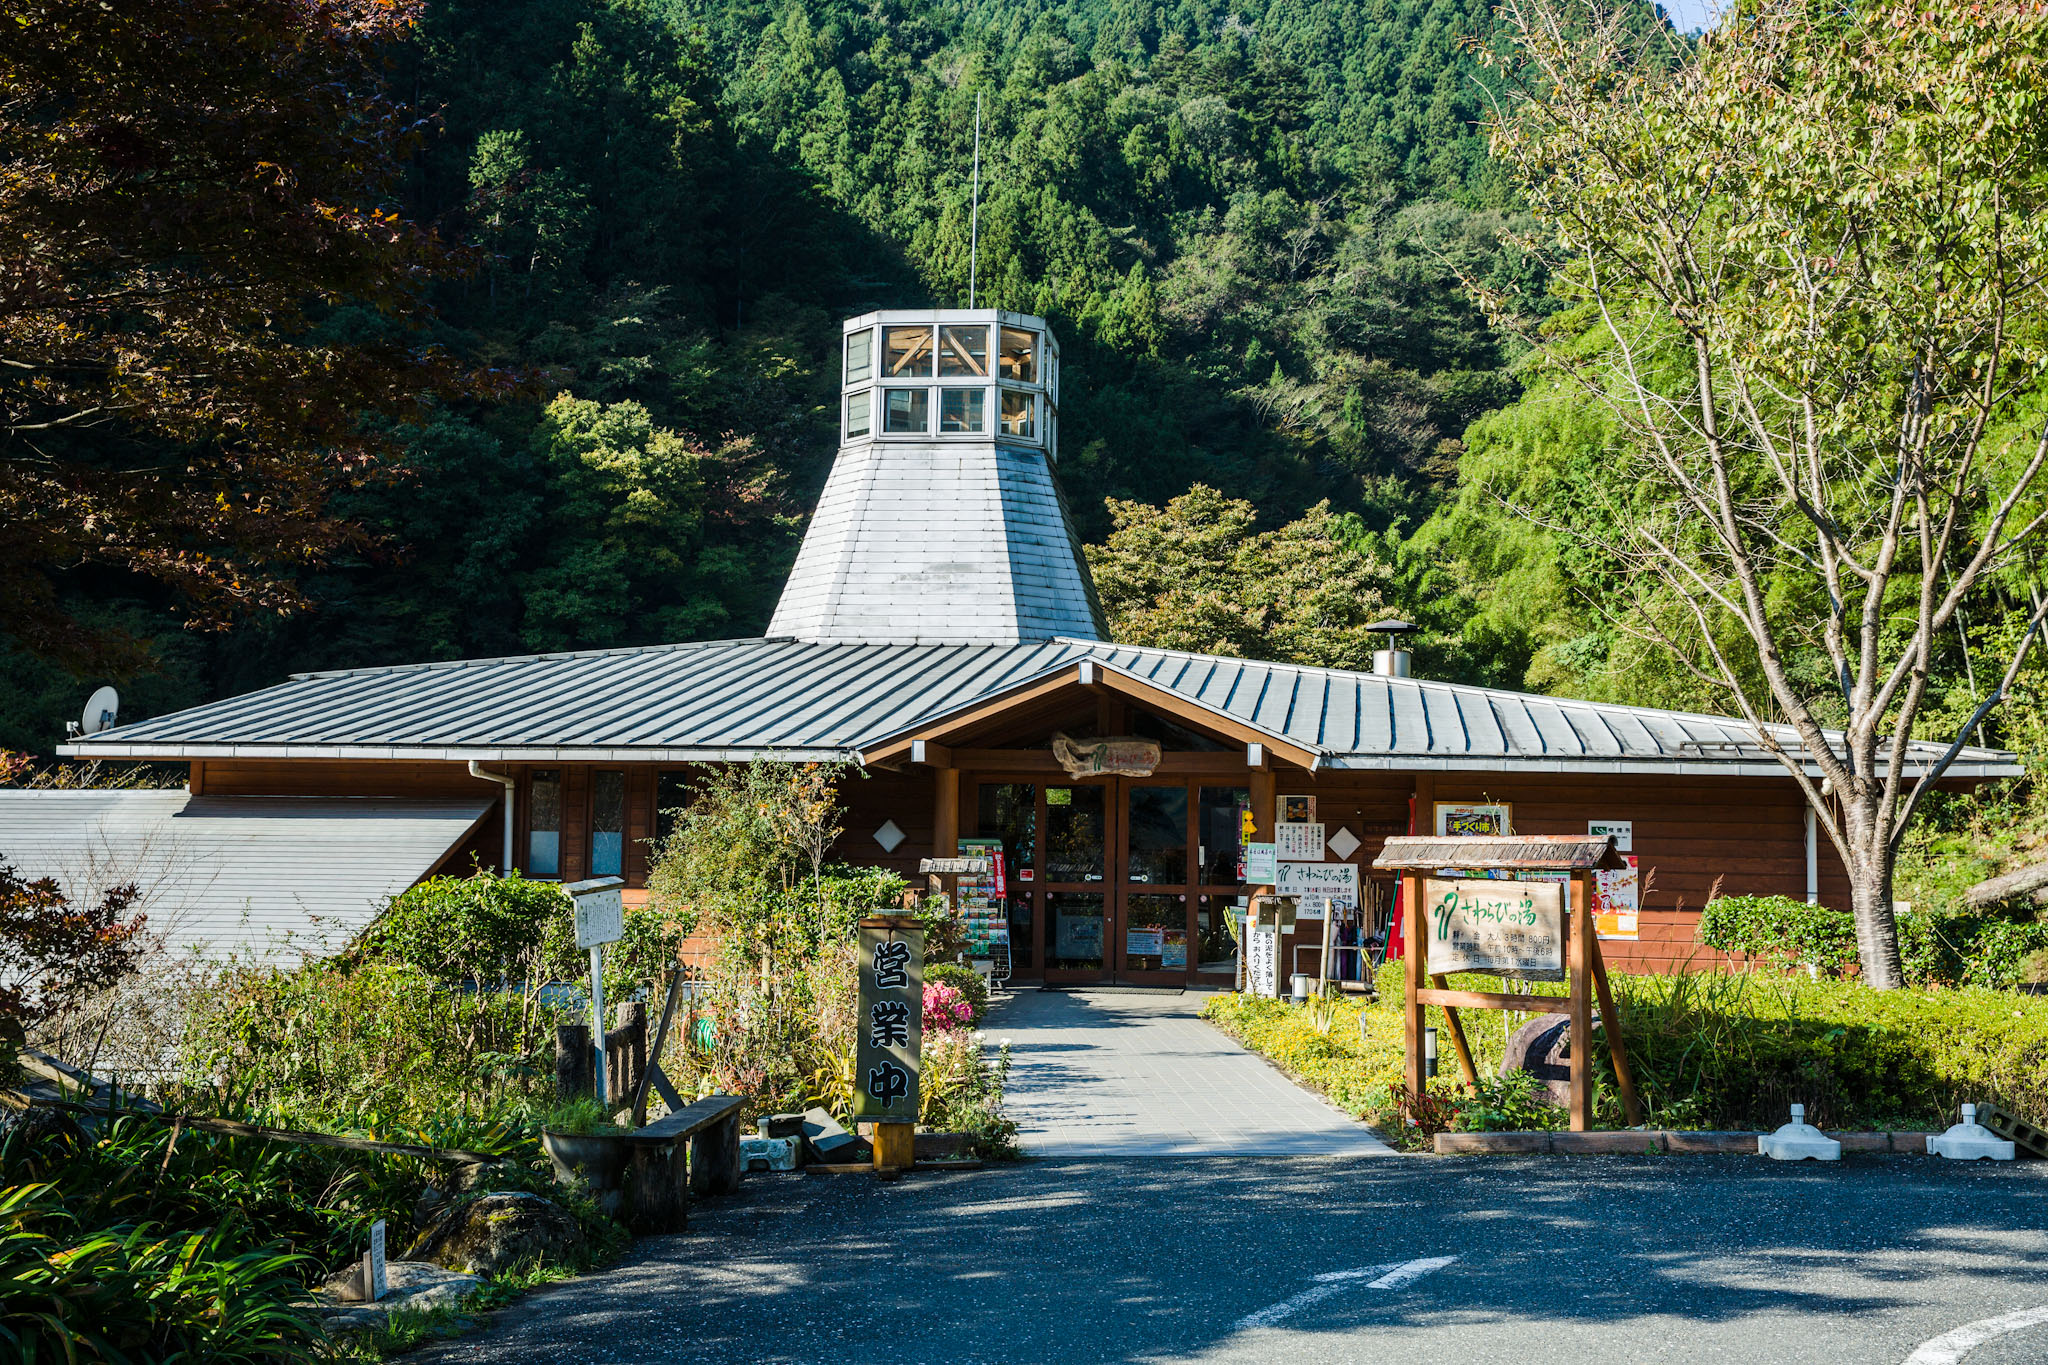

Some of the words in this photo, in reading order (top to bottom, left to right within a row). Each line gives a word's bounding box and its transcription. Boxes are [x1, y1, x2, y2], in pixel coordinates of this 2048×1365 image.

[1296, 866, 1353, 884] さわらびの湯
[1461, 898, 1537, 926] さわらびの湯
[1528, 935, 1550, 945] 800円
[868, 940, 912, 1110] 営業中
